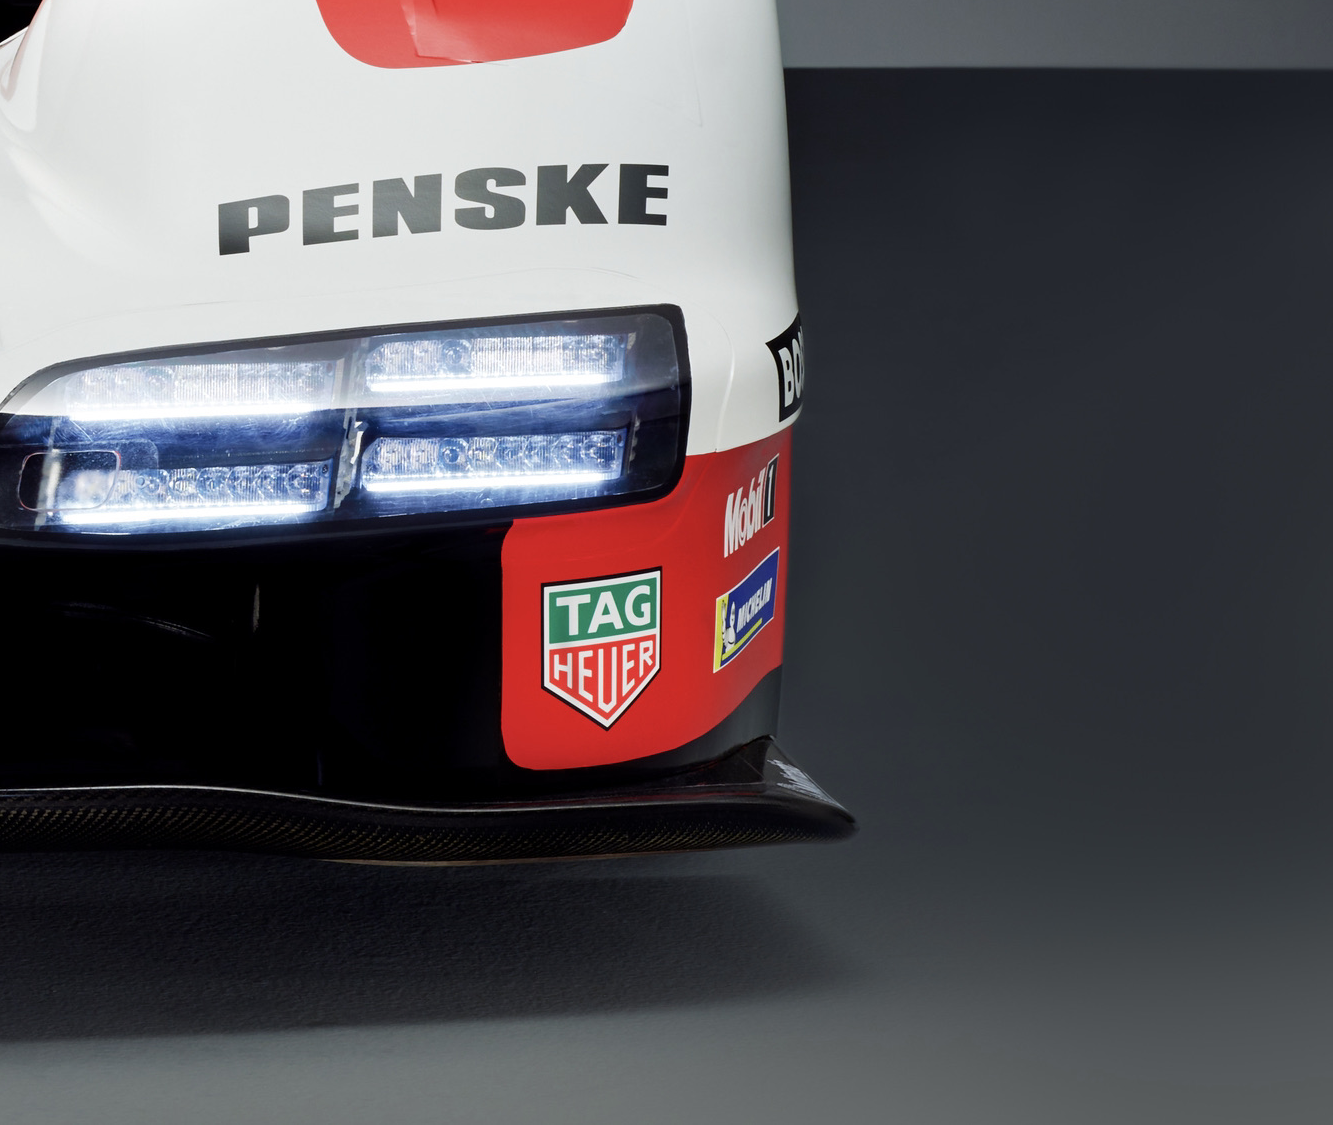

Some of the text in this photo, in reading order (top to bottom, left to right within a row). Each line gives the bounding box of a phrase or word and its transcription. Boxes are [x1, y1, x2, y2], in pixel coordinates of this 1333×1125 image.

[218, 163, 670, 256] PENSKE
[724, 467, 766, 558] Mobil
[556, 585, 651, 636] TAG
[736, 577, 773, 633] MICHELIN
[554, 639, 654, 713] HEUER
